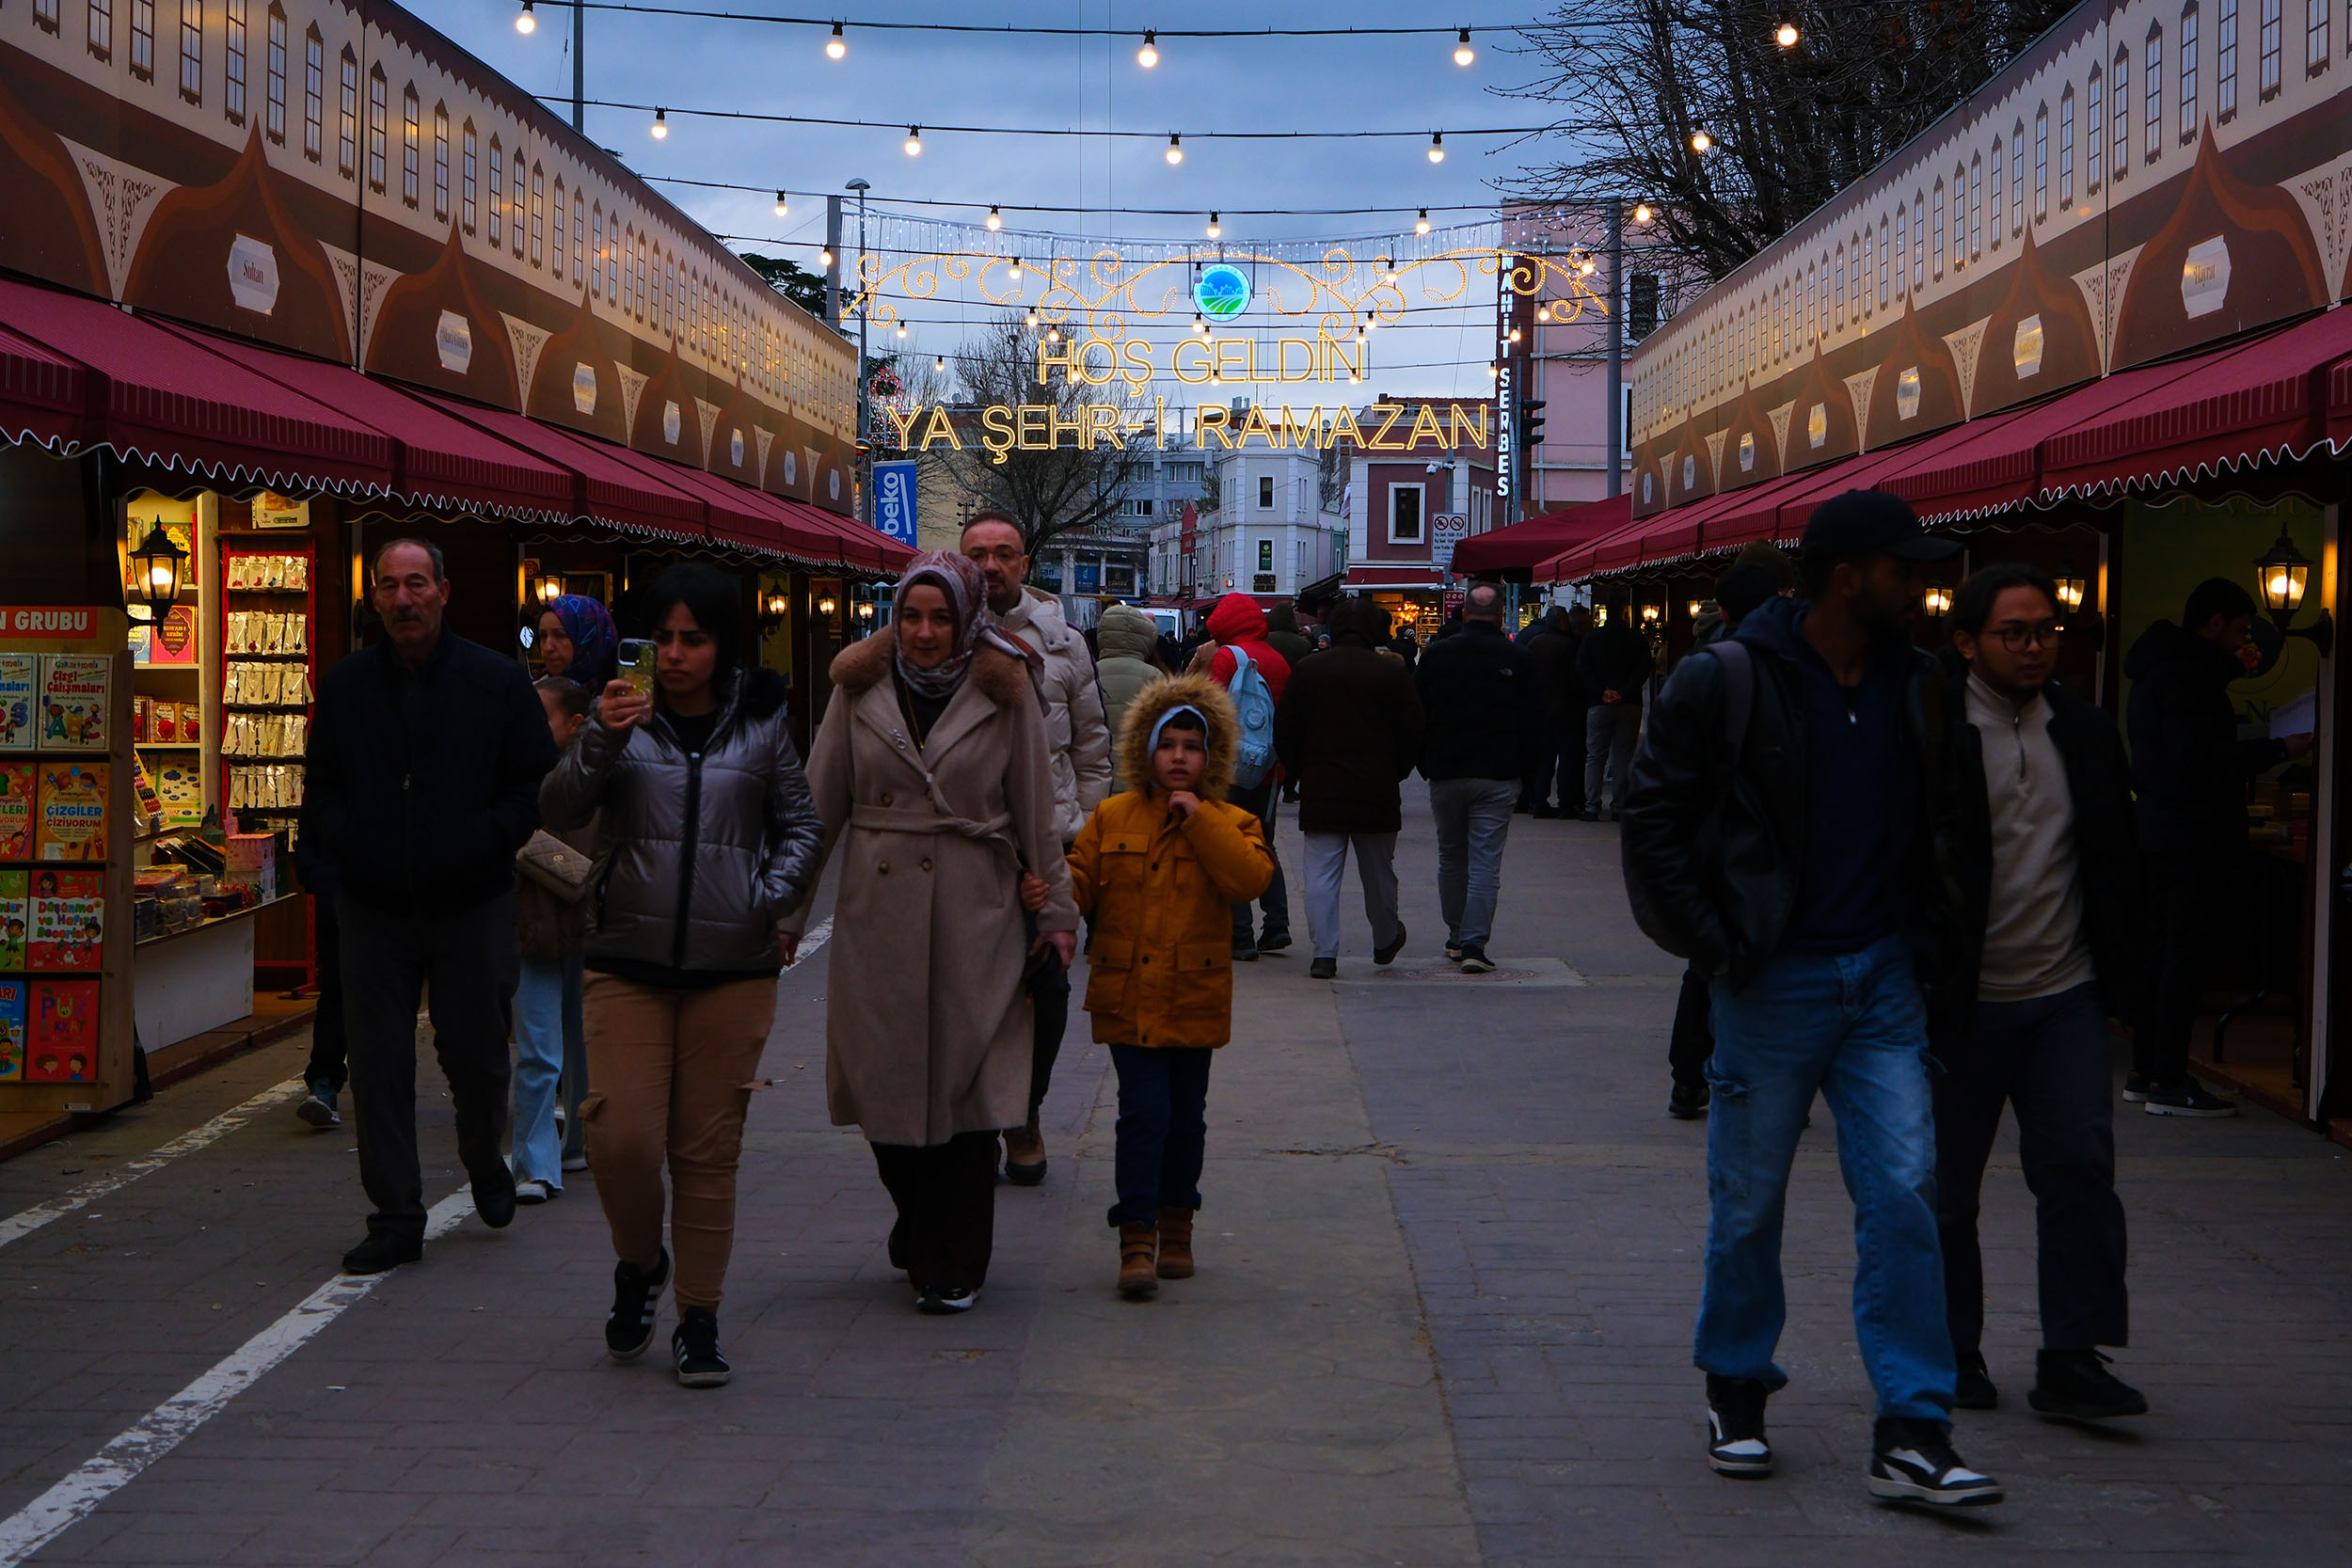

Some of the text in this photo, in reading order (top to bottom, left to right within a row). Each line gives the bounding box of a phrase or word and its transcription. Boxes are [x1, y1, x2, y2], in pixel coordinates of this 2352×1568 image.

[1040, 331, 1362, 395] HOŞ GELDİN
[886, 395, 1487, 464] YA ŞEHR-İ RAMAZAN
[1497, 368, 1510, 498] SERBES
[881, 472, 899, 535] beko
[15, 611, 87, 631] GRUBU
[0, 681, 29, 691] maları
[0, 802, 27, 815] LERİ
[47, 802, 102, 818] ÇİZGİLER
[46, 817, 101, 828] ÇİZİYORUM
